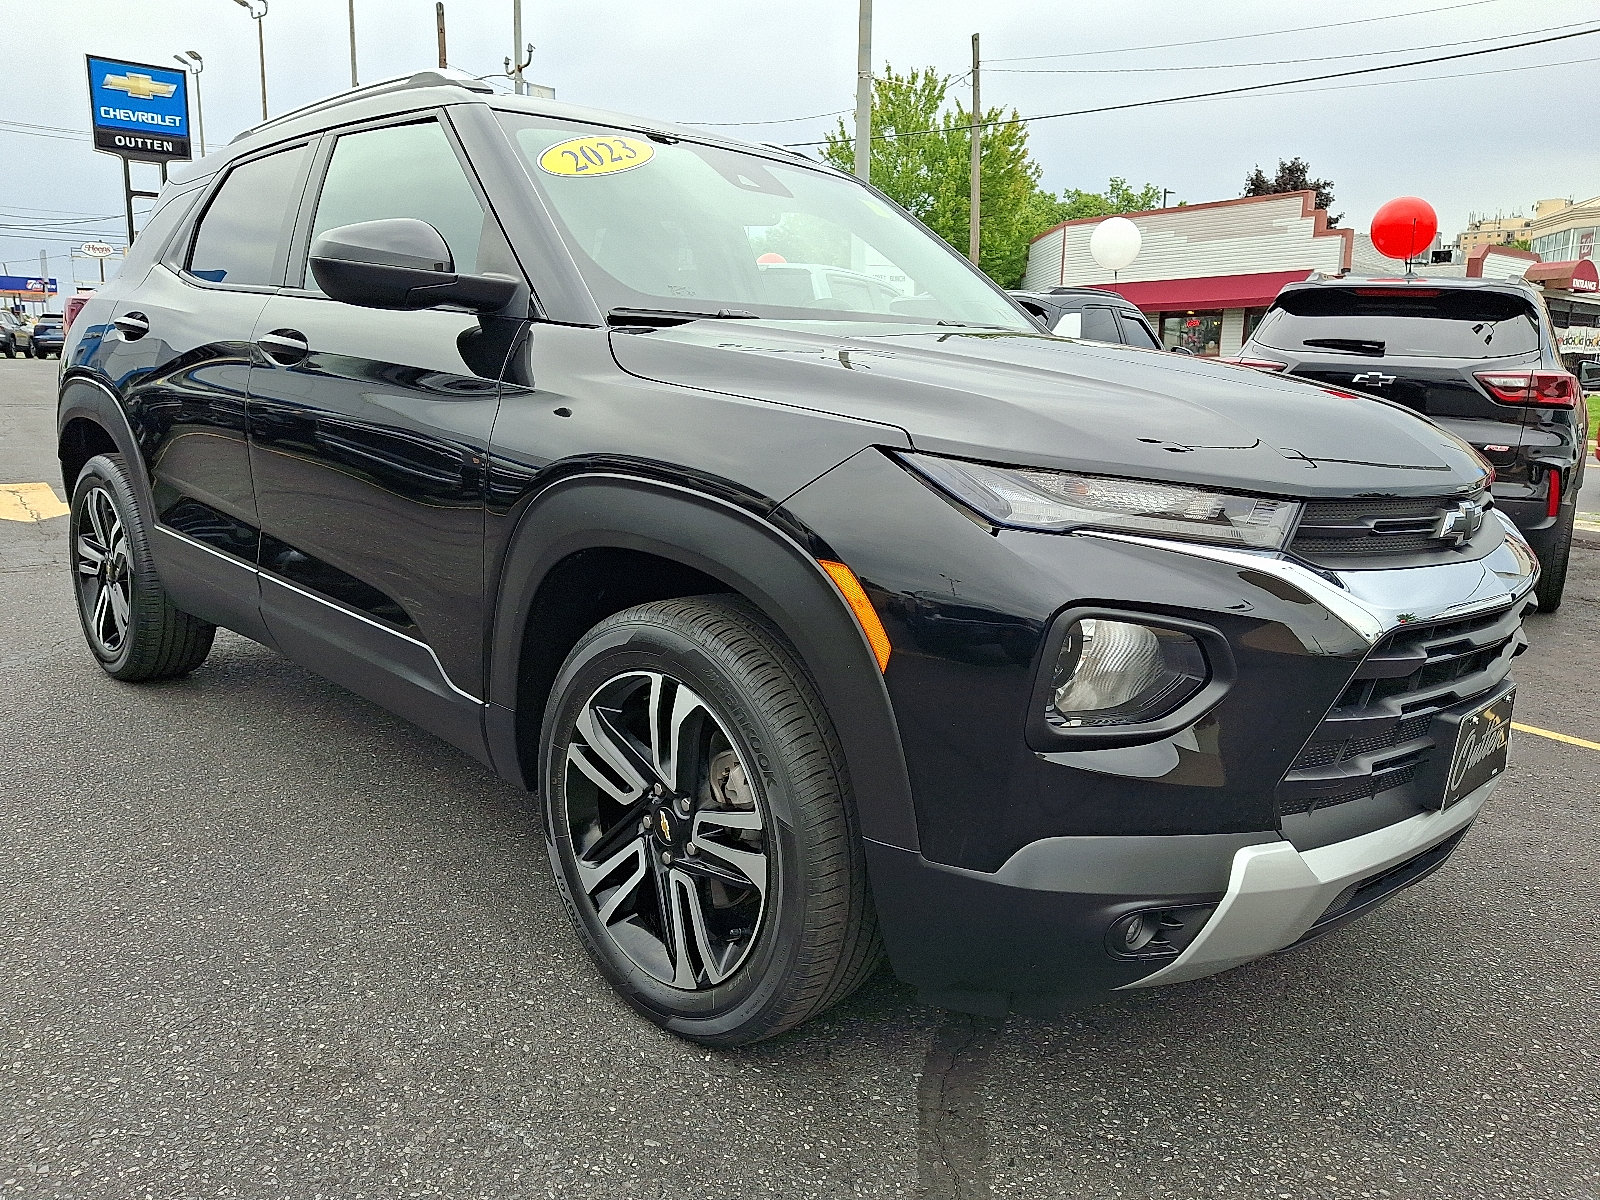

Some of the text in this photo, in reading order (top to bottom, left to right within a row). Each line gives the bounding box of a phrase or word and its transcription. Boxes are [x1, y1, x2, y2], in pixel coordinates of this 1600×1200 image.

[100, 106, 182, 127] CHEVROLET
[115, 135, 173, 152] OUTTEN
[561, 139, 637, 172] 2023
[1572, 278, 1597, 290] ENTRANCE
[714, 680, 778, 789] Hankook
